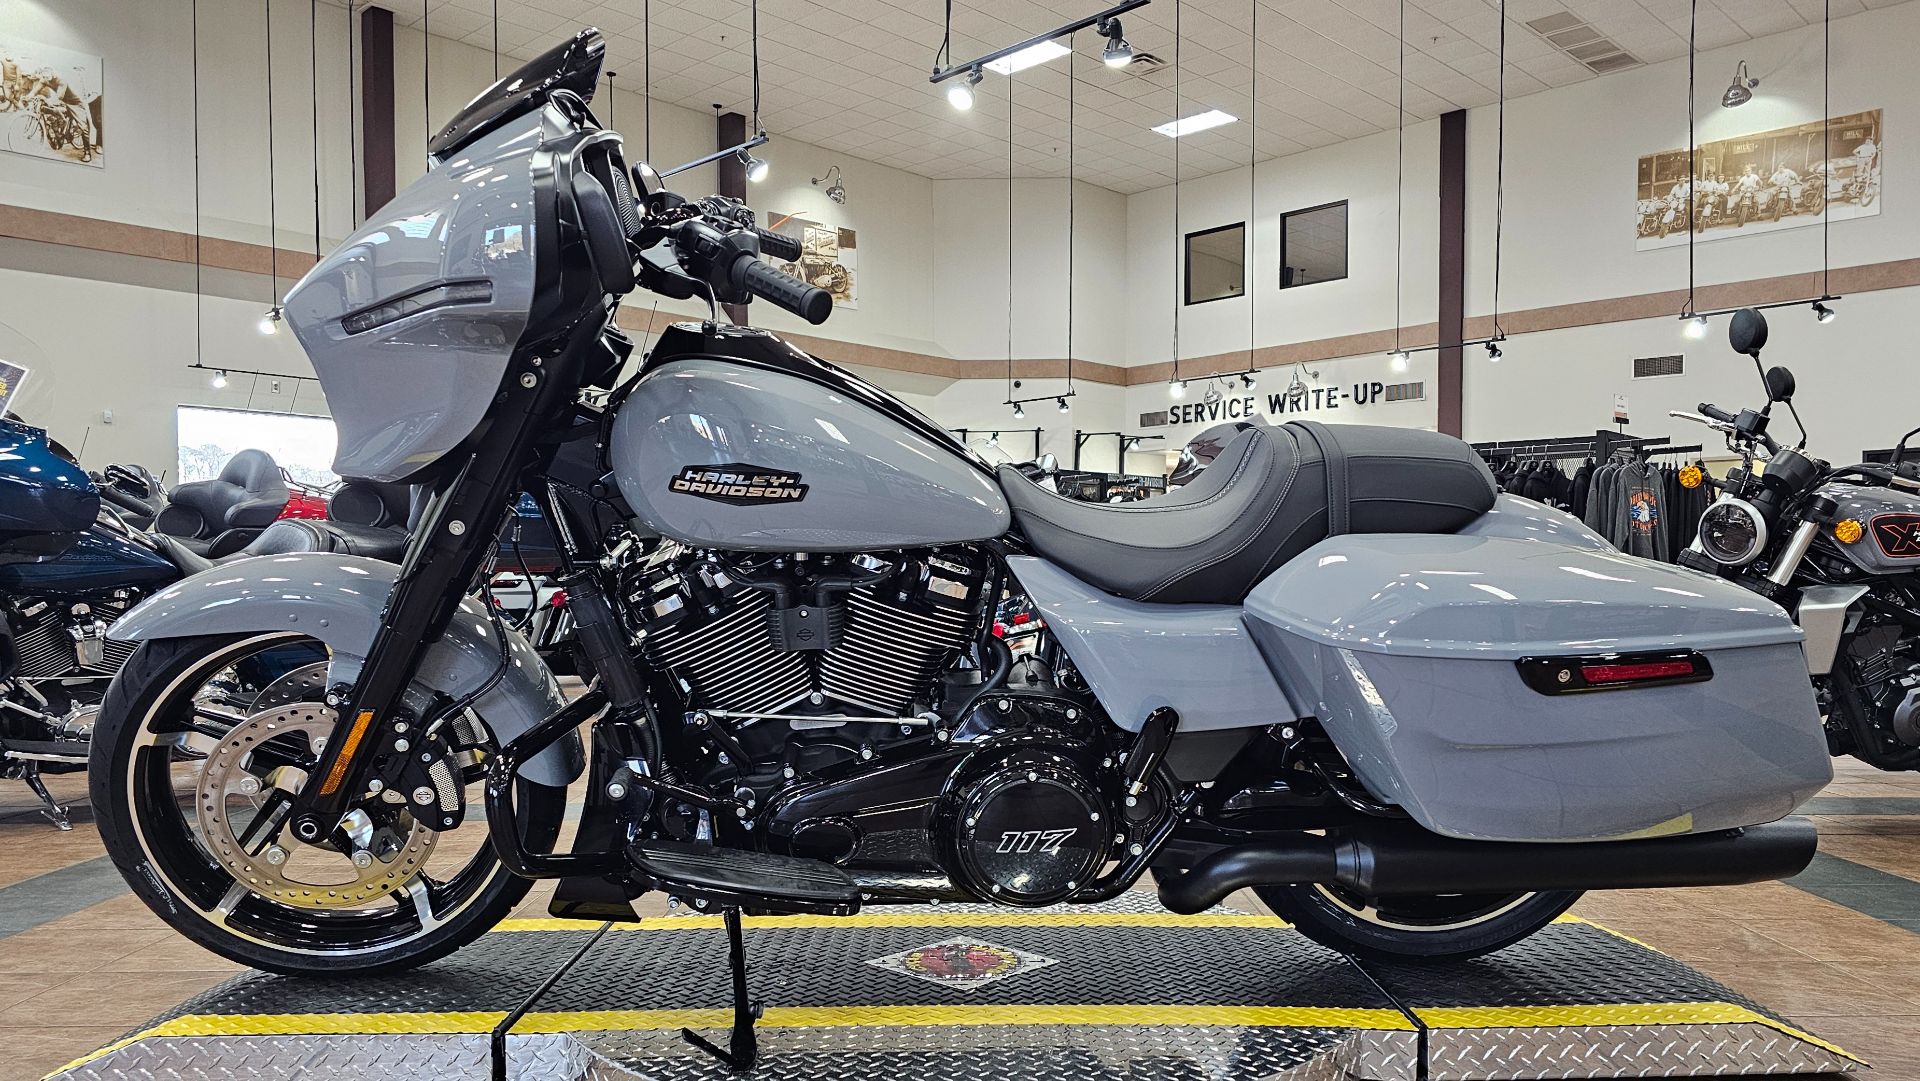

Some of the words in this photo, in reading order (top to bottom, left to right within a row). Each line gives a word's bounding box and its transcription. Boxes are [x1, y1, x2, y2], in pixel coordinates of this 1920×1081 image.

[1169, 397, 1254, 424] SERVICE
[1268, 382, 1383, 414] WRITE-UP
[673, 480, 801, 498] DAVIDSON
[684, 470, 795, 486] HARLEY-
[996, 827, 1078, 854] 117
